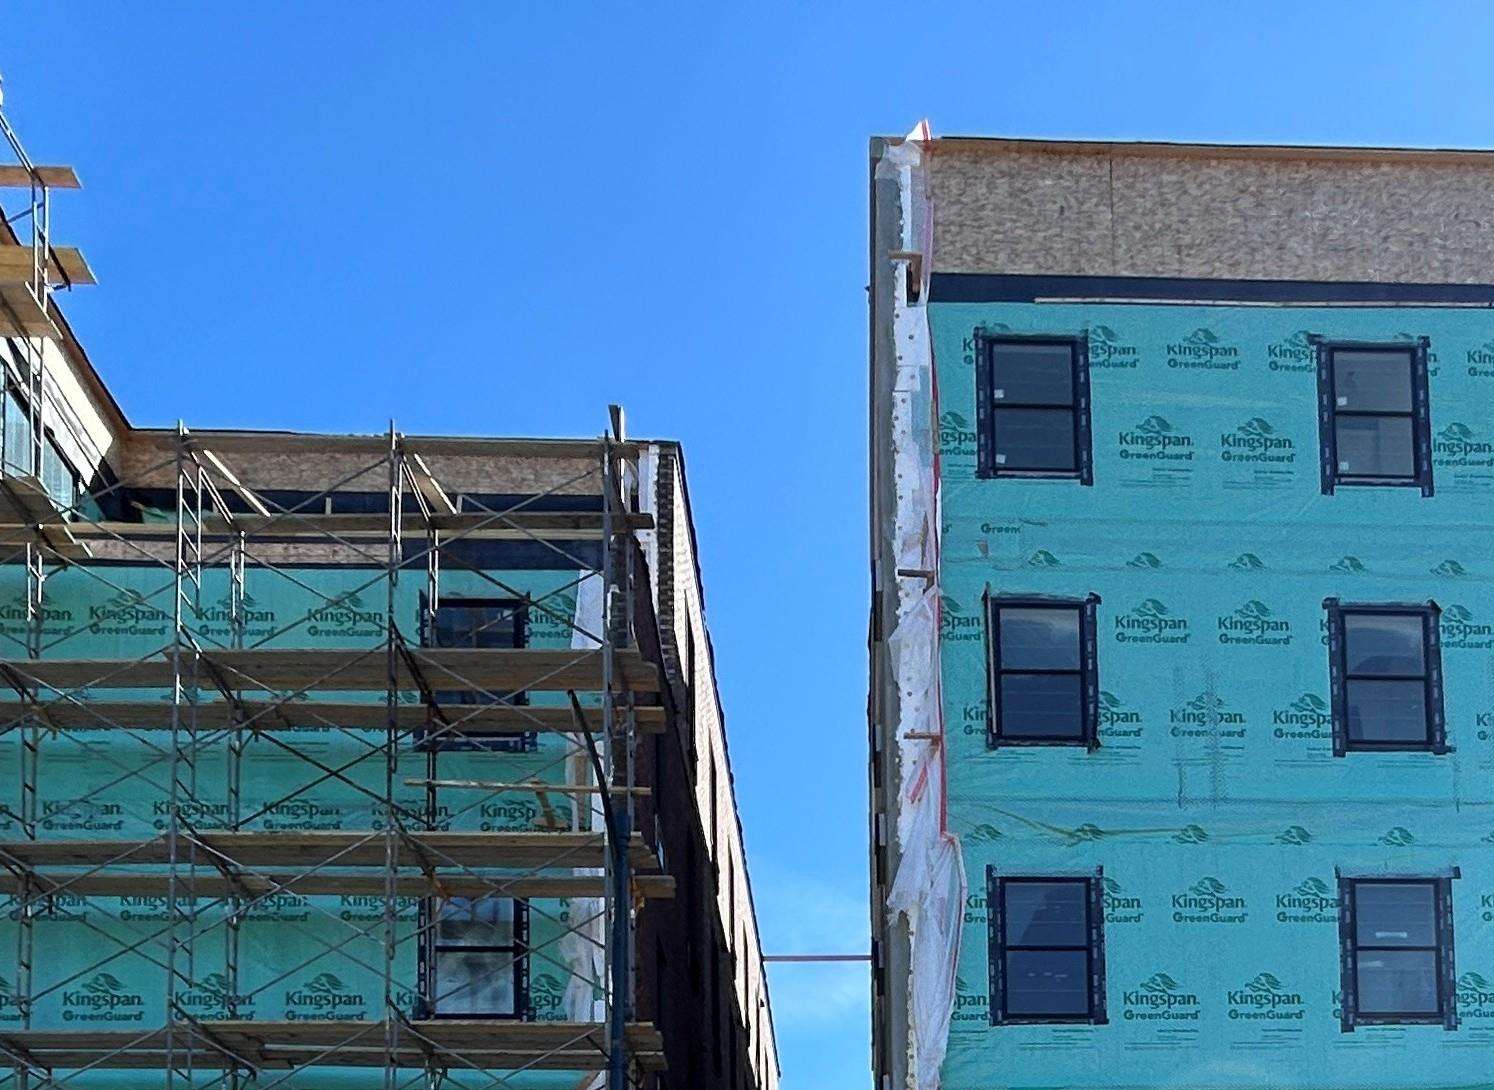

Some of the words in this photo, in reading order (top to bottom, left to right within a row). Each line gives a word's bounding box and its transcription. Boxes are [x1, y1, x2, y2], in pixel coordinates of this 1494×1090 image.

[1433, 440, 1494, 457] ingspan
[1103, 895, 1141, 910] span
[1276, 895, 1338, 911] Kingspa
[1104, 913, 1144, 922] Guard
